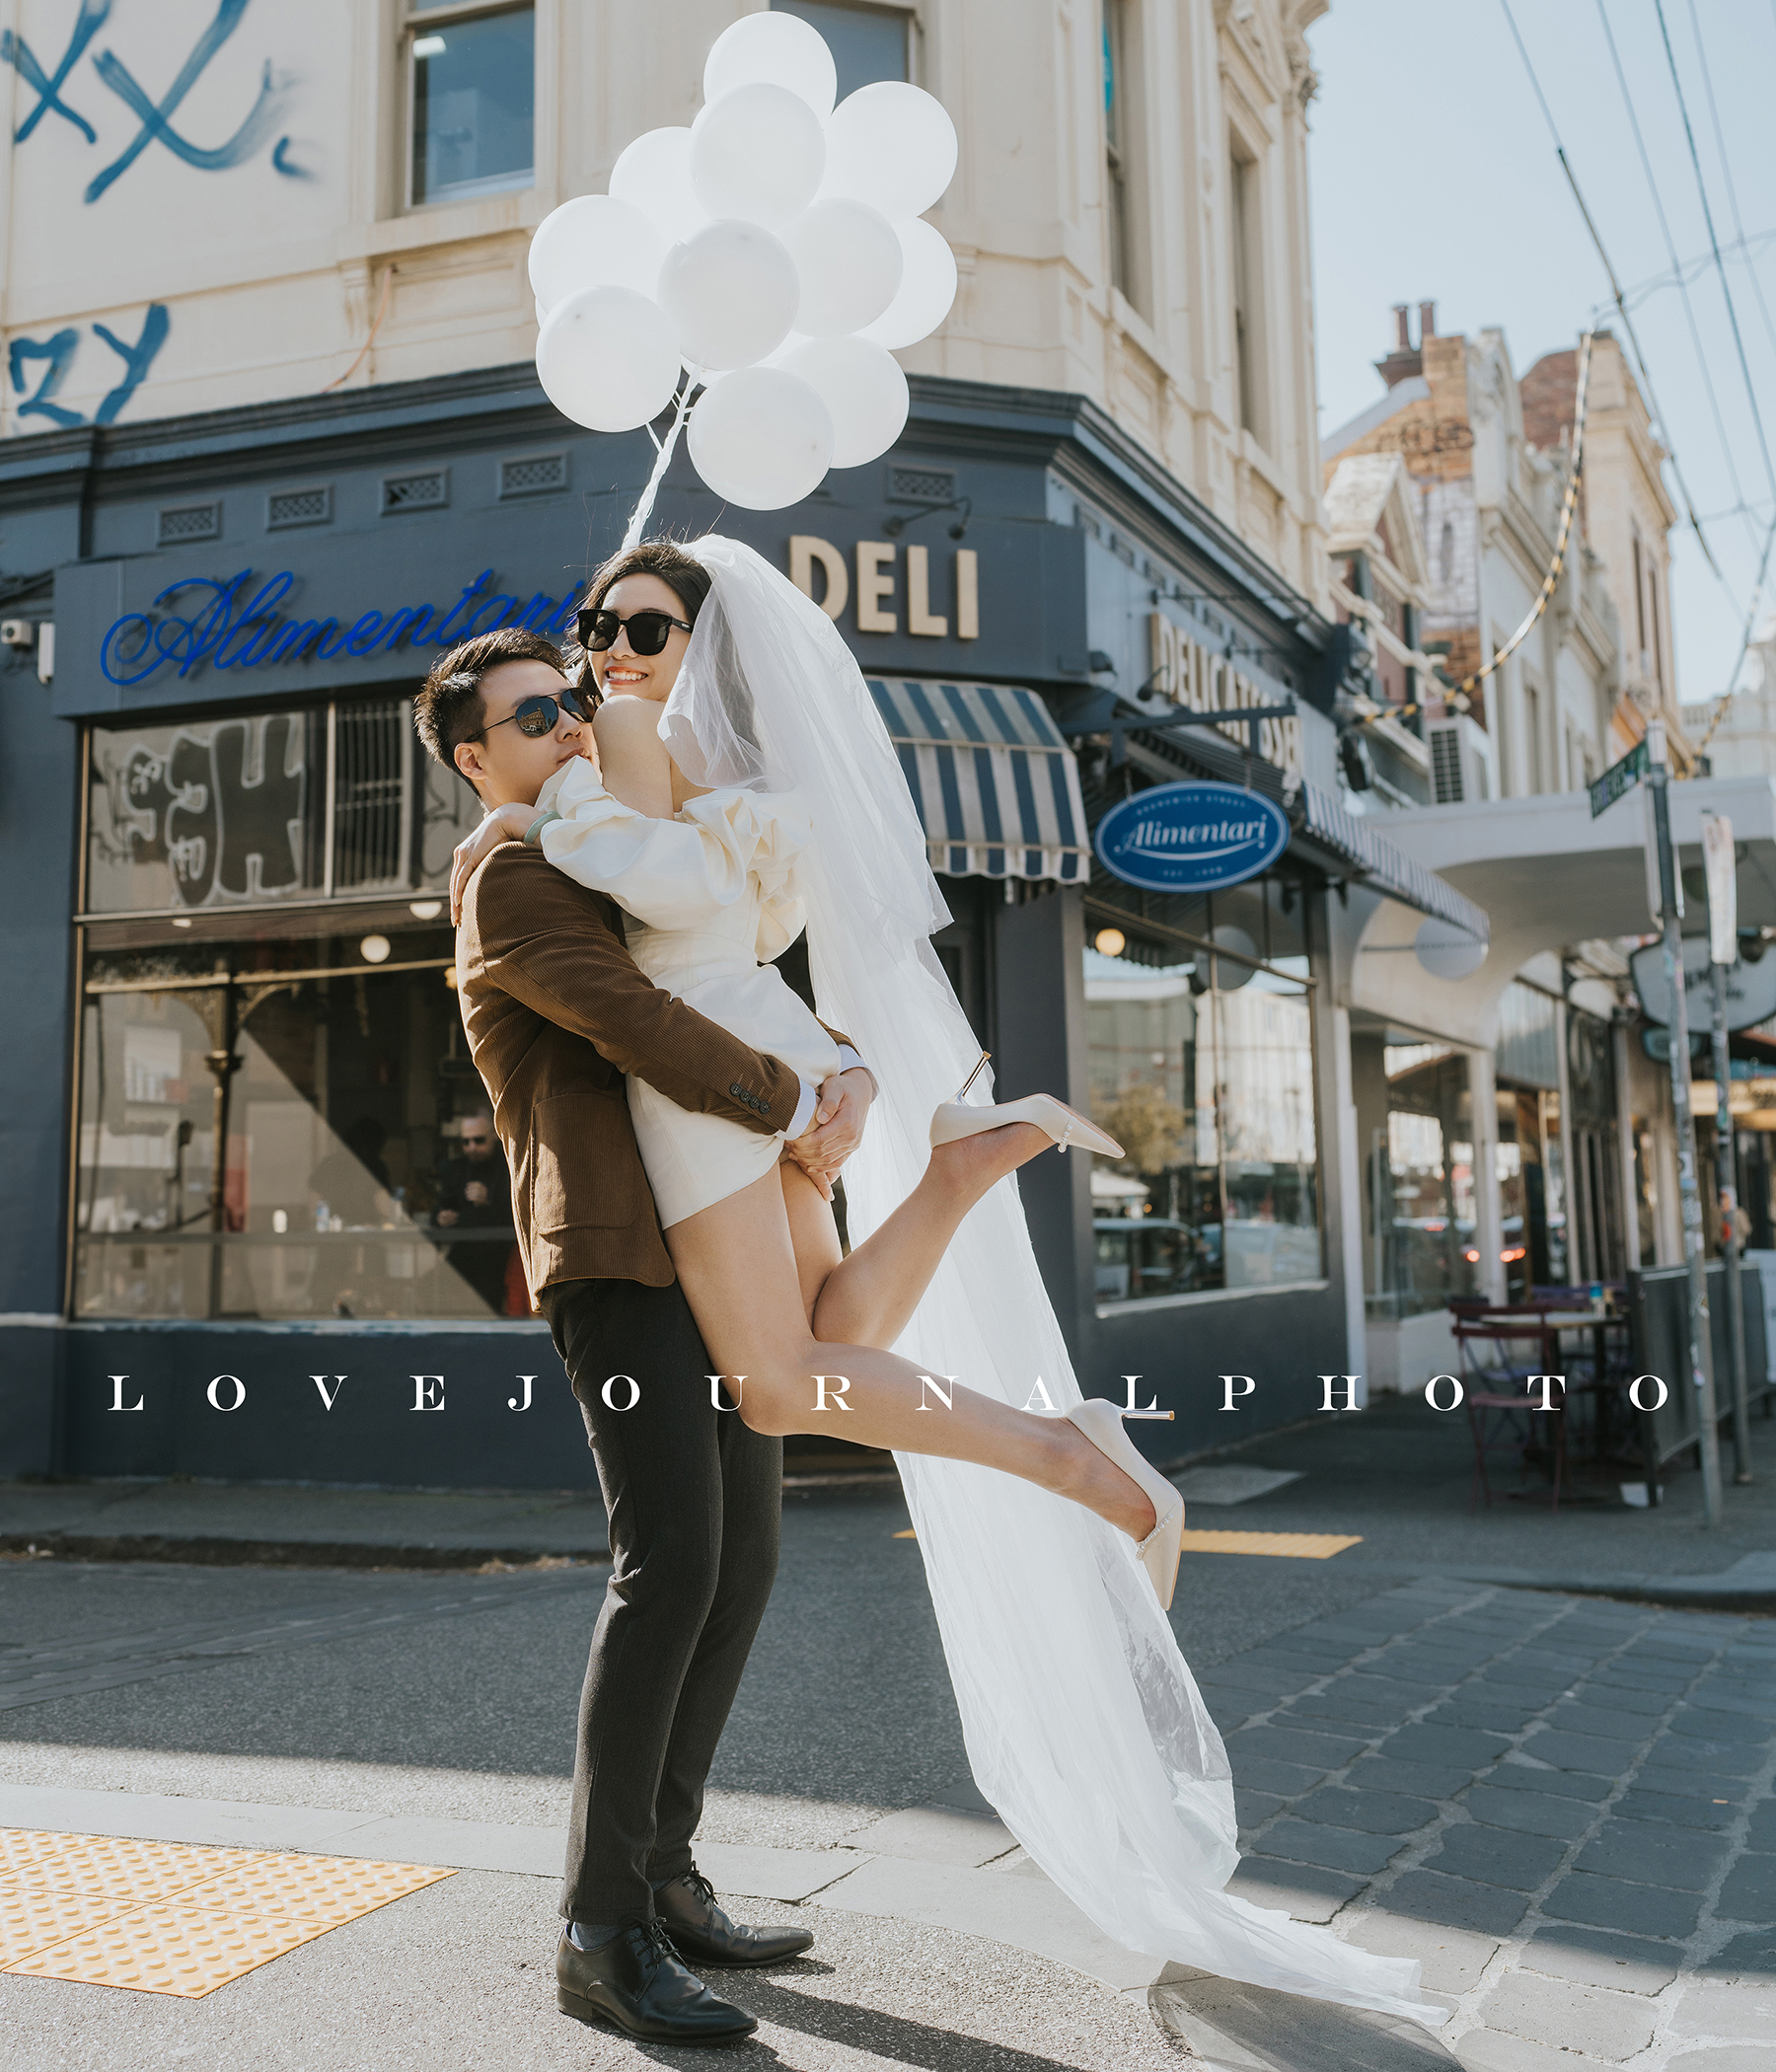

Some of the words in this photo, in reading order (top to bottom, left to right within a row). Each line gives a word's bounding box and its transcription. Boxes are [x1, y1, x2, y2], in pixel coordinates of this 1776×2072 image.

[101, 568, 584, 685] Alimentari
[789, 535, 979, 639] DELI
[1113, 813, 1268, 858] Alimentari
